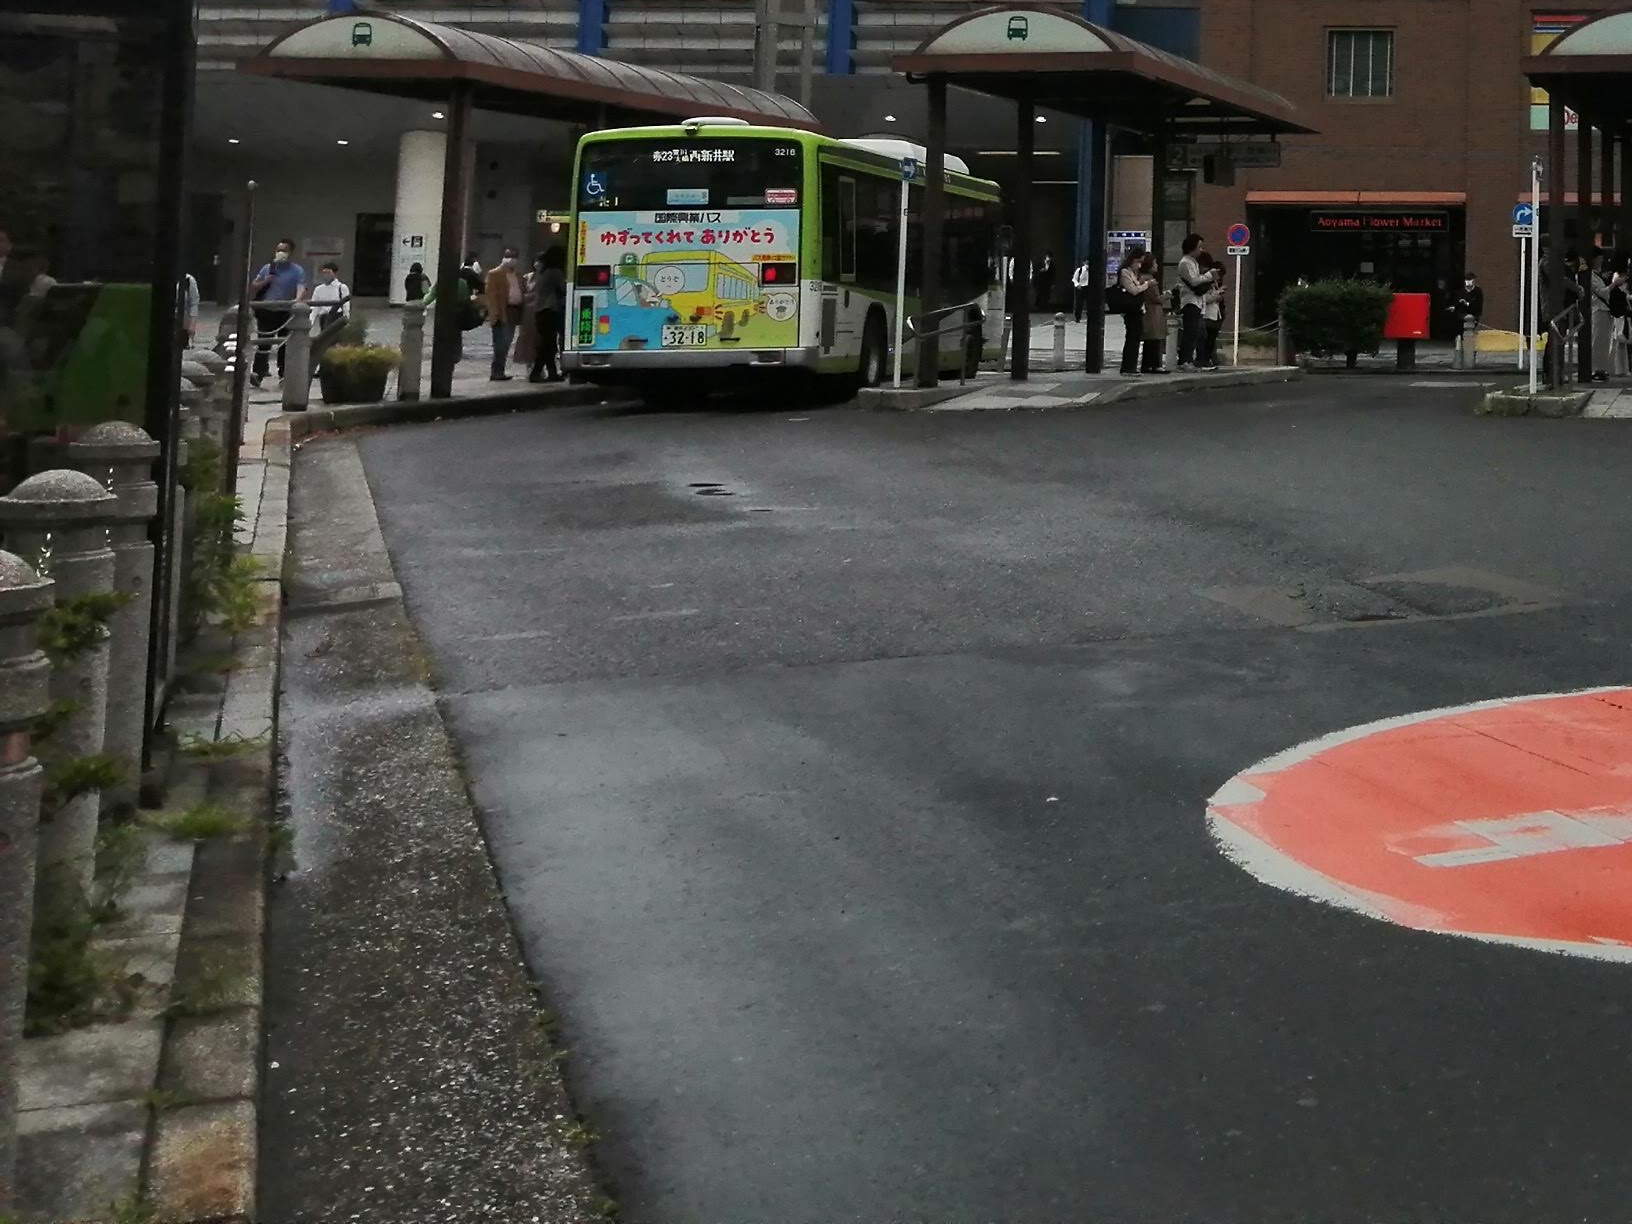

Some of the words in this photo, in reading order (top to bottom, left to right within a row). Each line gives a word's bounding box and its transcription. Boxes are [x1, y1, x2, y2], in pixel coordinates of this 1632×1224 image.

[1317, 216, 1360, 228] Aoyama
[1402, 216, 1443, 228] Market
[600, 227, 695, 246] ゆずってくれて
[701, 226, 776, 245] ありがとう
